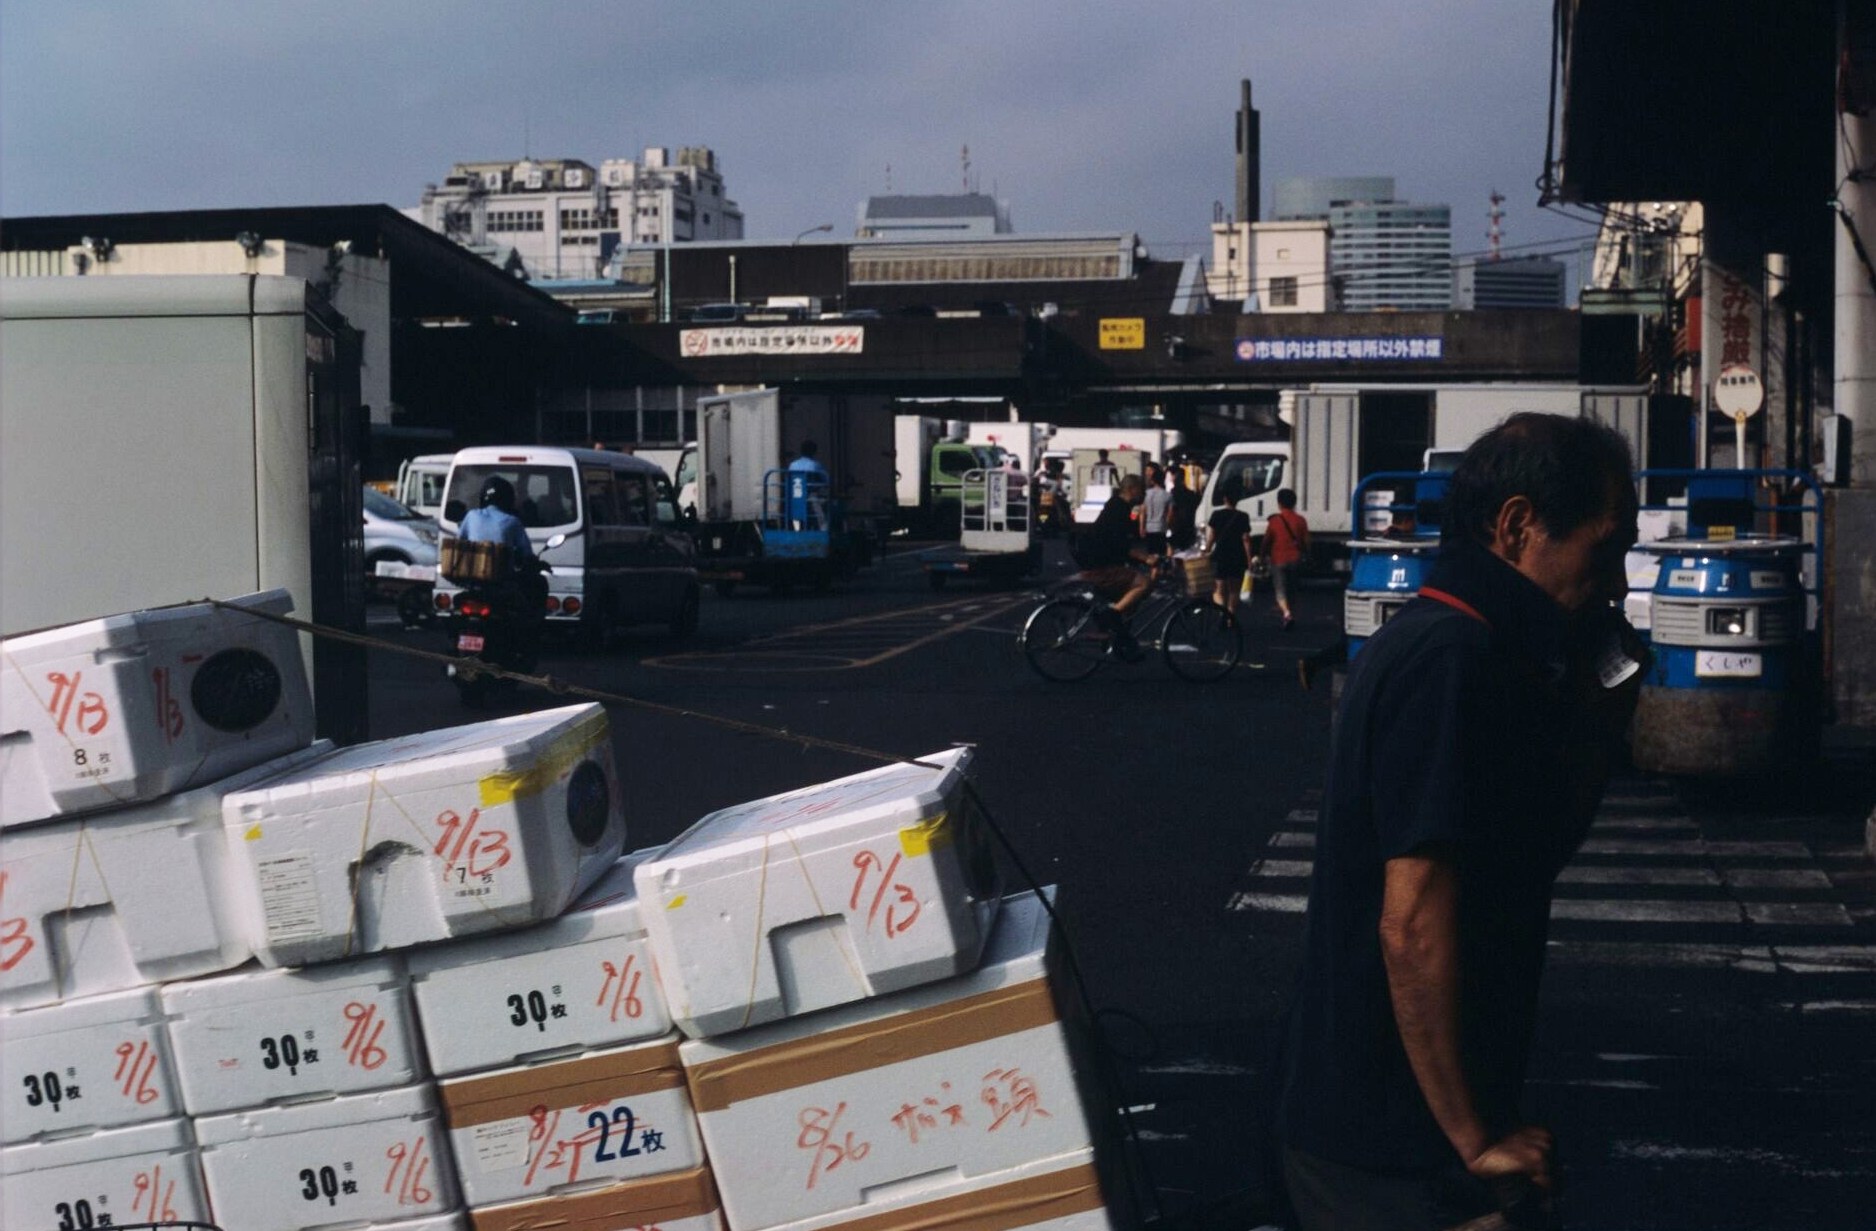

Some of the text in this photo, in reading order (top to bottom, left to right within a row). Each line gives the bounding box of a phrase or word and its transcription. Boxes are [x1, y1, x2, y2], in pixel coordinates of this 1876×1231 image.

[47, 671, 109, 735] 9/13
[434, 807, 511, 882] 9/13
[850, 850, 921, 940] 9/13
[341, 1002, 388, 1070] 9/6
[114, 1041, 159, 1104] 9/6
[383, 1136, 432, 1205] 9/6
